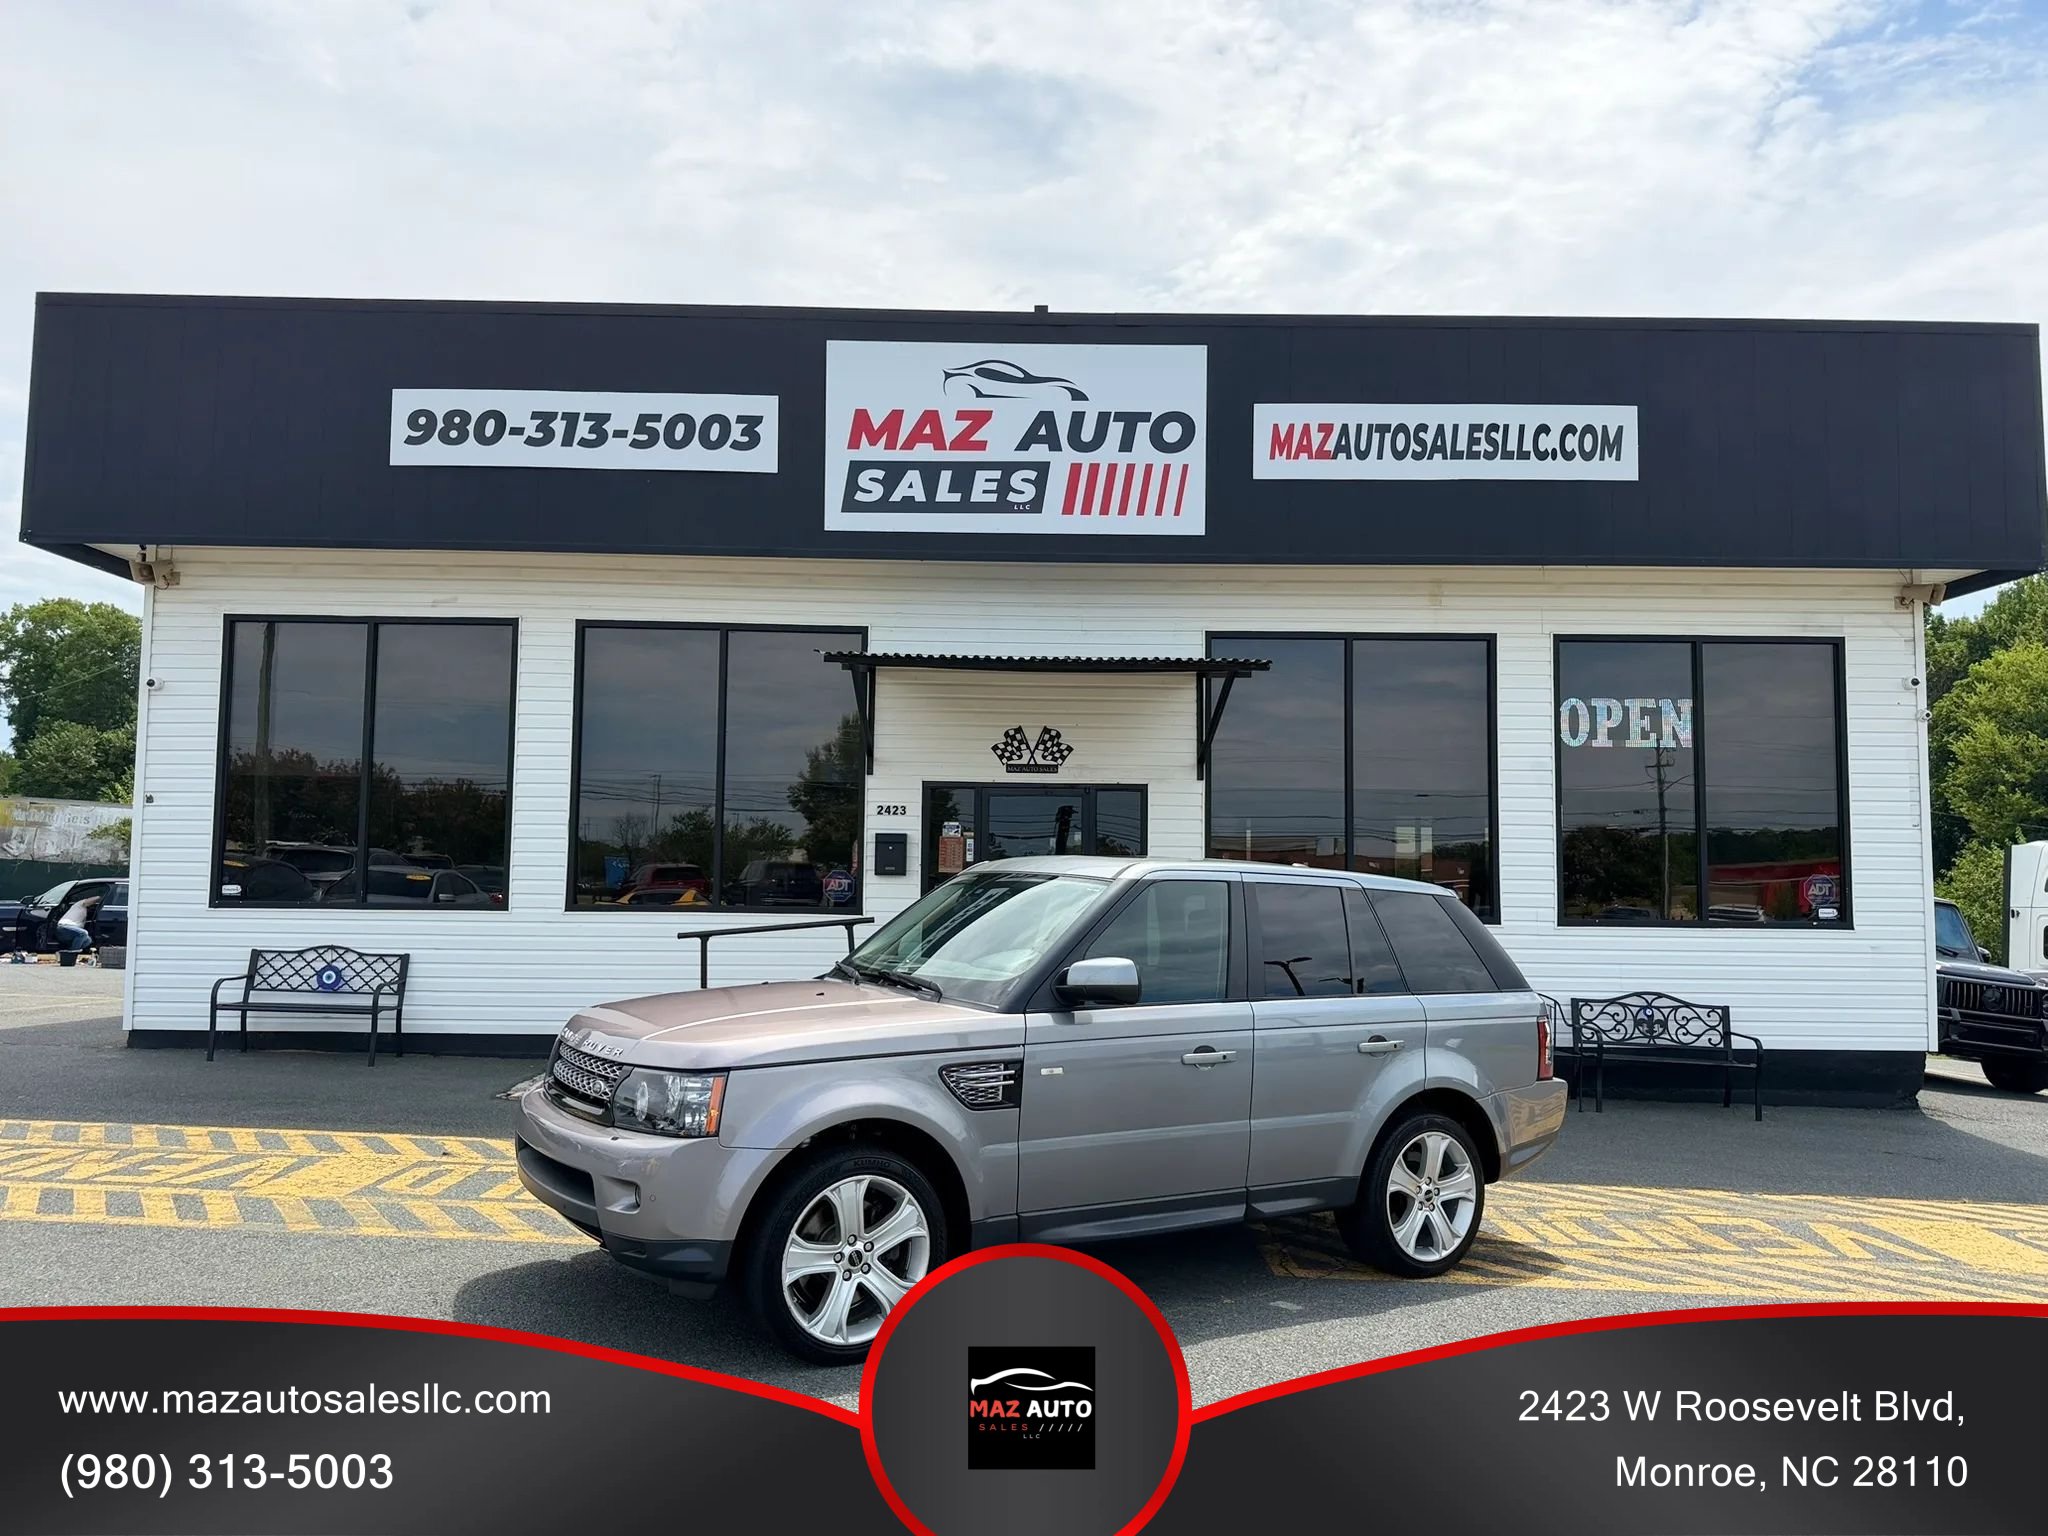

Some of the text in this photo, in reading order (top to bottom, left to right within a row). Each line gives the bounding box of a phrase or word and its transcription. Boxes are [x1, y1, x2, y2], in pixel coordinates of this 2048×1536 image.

[404, 408, 764, 453] 980-313-5003
[848, 409, 1196, 453] MAZ AUTO
[1269, 422, 1625, 463] MAZAUTOSALESLLC.COM
[853, 468, 1038, 503] SALES
[1559, 697, 1693, 749] OPEN
[876, 805, 907, 816] 2423
[825, 878, 852, 892] ADT
[1807, 882, 1833, 896] ADT
[582, 1039, 624, 1057] ROVER
